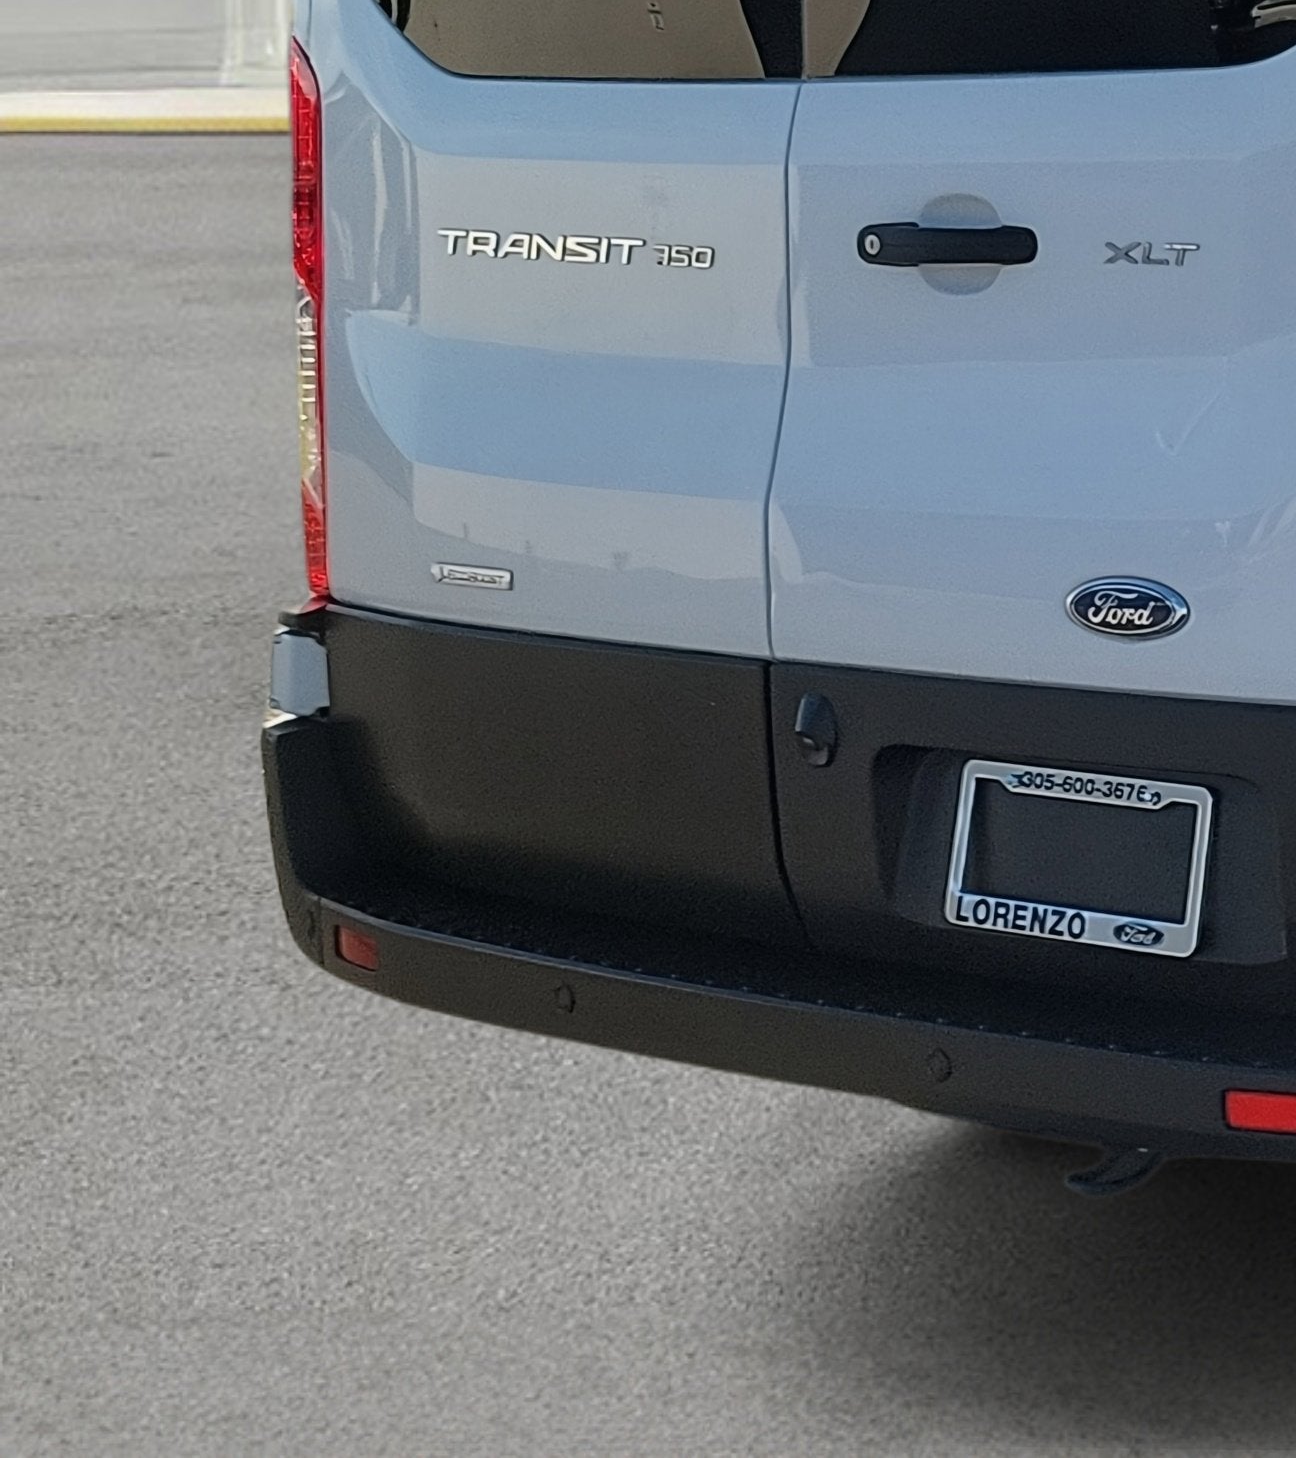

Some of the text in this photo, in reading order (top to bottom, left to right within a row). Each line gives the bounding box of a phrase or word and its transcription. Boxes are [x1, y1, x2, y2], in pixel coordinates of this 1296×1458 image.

[436, 228, 647, 266] TRANSIT
[1103, 242, 1200, 267] XLT
[1087, 590, 1155, 625] Ford
[955, 895, 1086, 939] LORENZO
